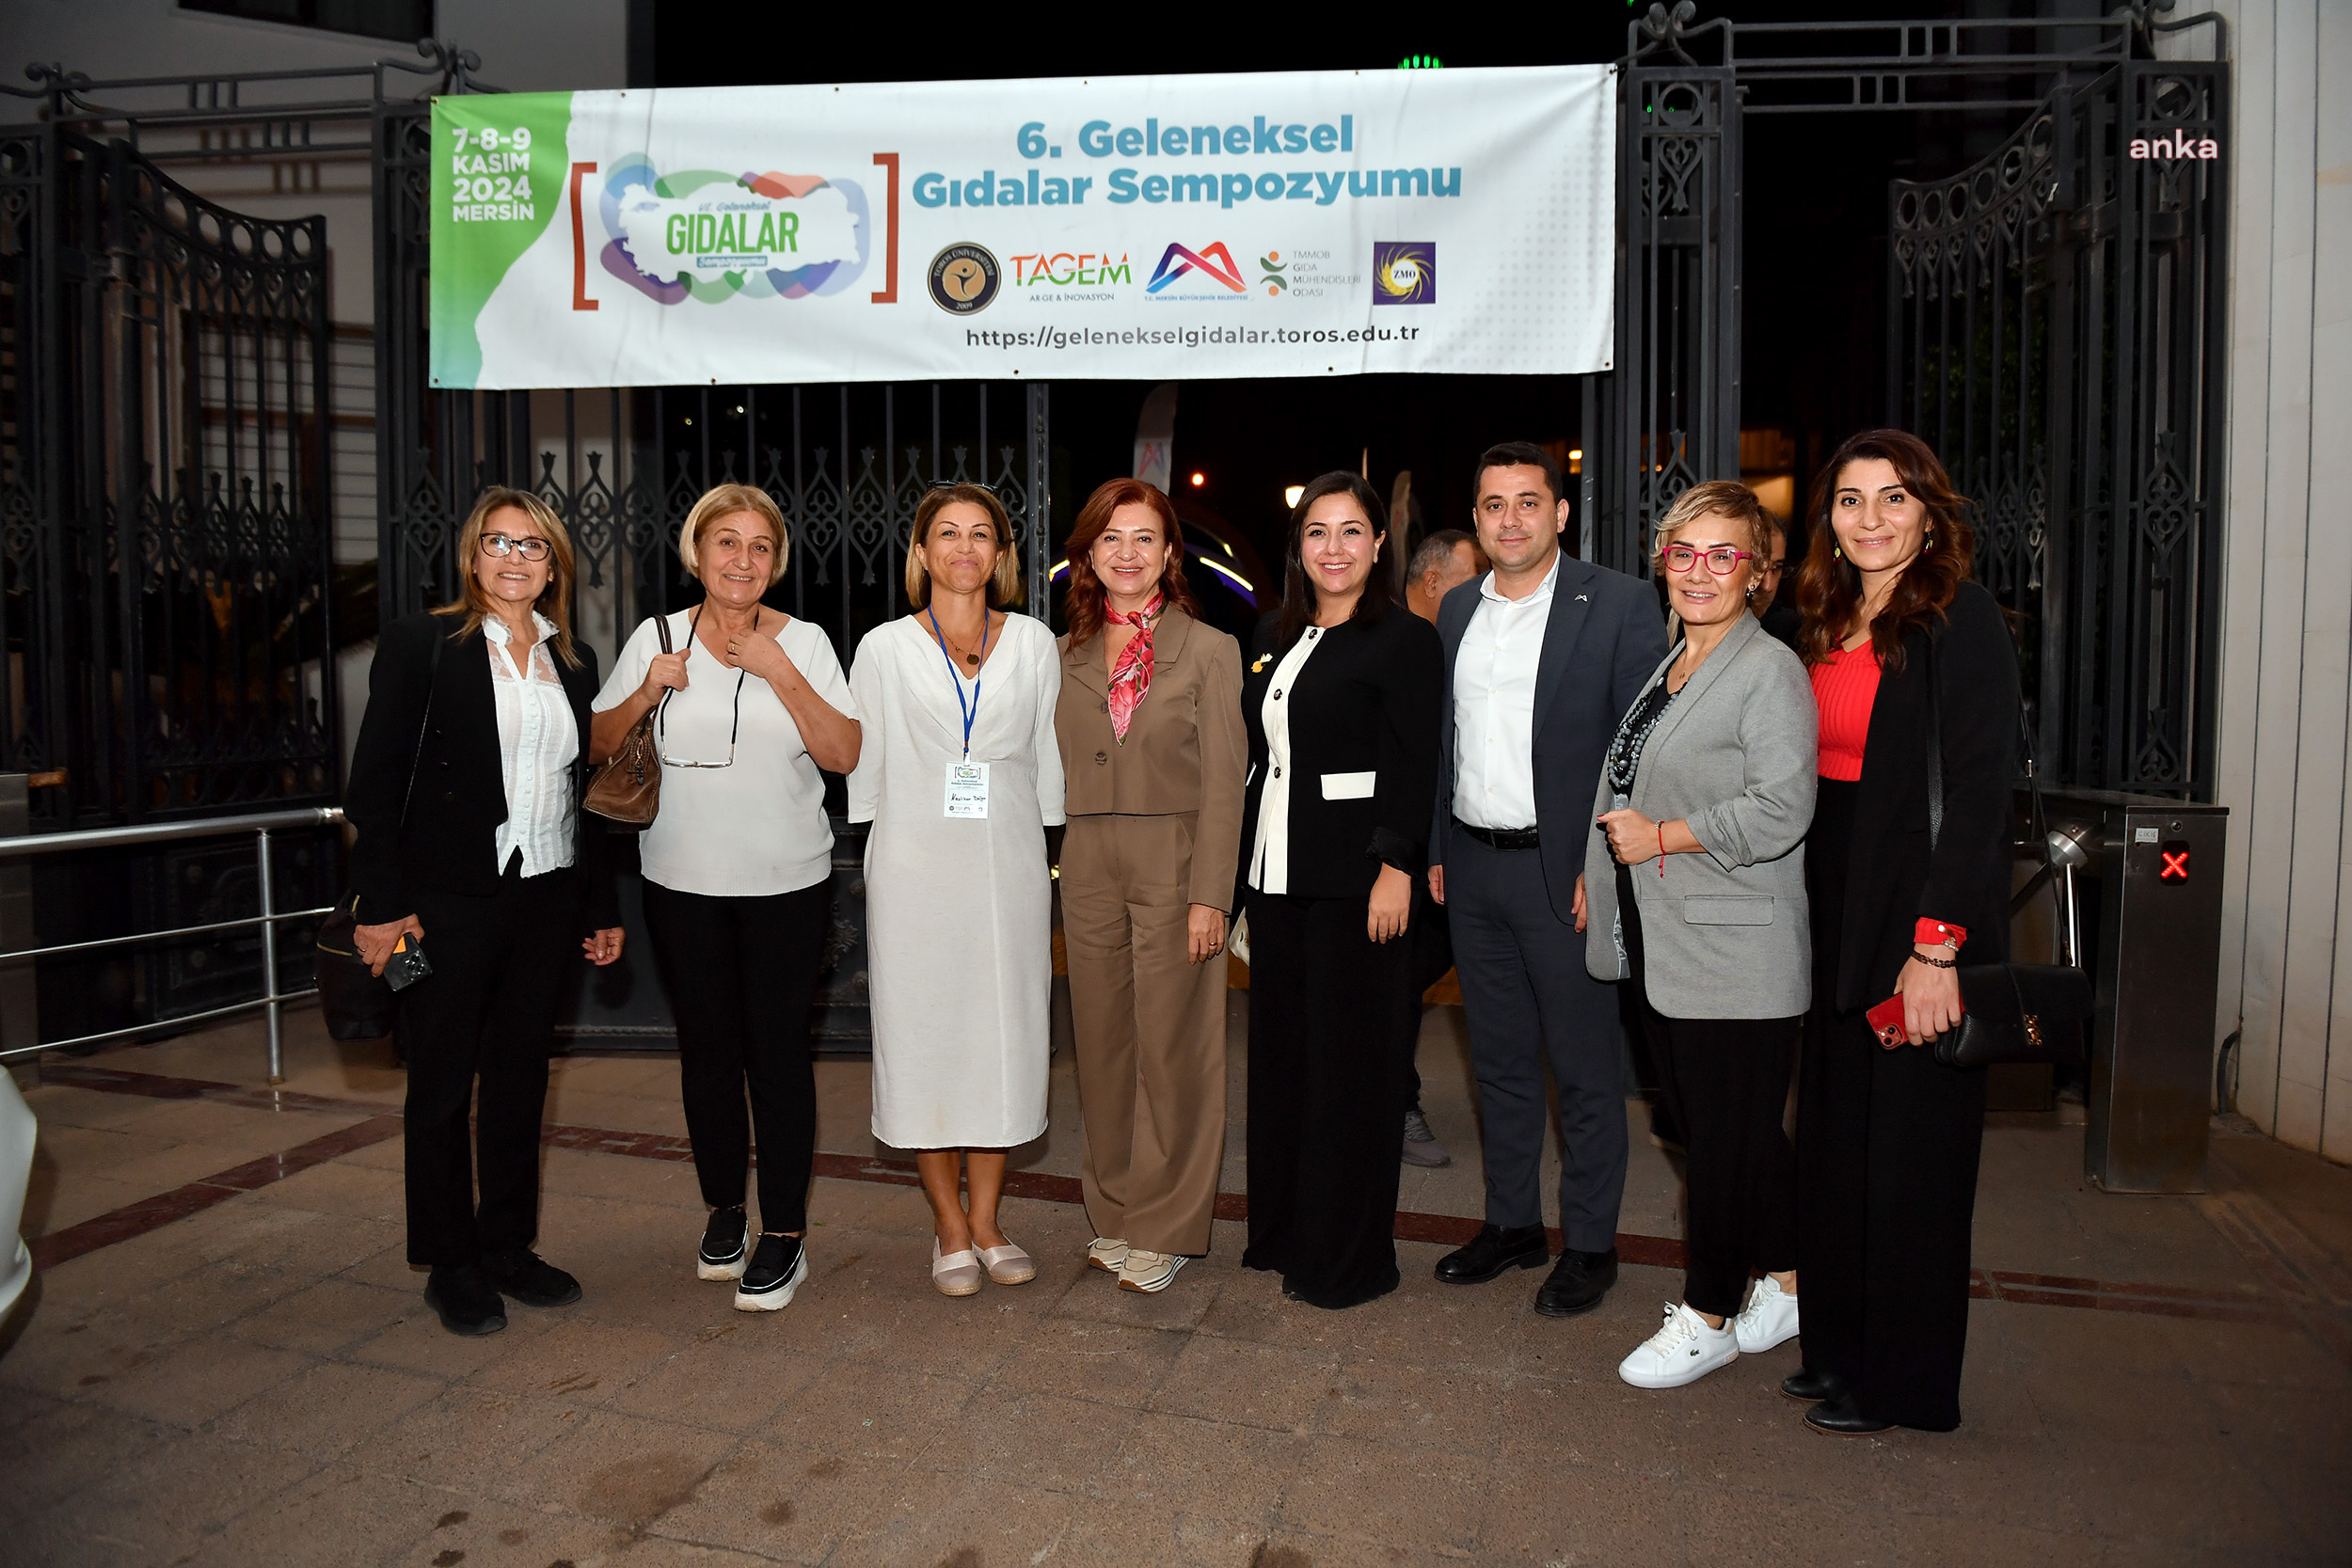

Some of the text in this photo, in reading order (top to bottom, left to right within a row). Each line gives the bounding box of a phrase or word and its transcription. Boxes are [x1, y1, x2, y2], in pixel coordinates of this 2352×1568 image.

[453, 127, 532, 152] 7-8-9
[1017, 115, 1353, 159] 6. Geleneksel
[453, 152, 531, 174] KASIM
[453, 175, 532, 202] 2024
[913, 166, 1462, 209] Gıdalar Sempozyumu
[453, 200, 534, 222] MERSİN
[667, 213, 799, 254] GIDALAR
[1293, 251, 1330, 260] TMMOB
[1293, 263, 1317, 272] GIDA
[1009, 252, 1132, 286] TAGEM
[1393, 270, 1416, 279] ZMO
[966, 325, 1420, 349] https://gelenekselgidalar.toros.edu.tr
